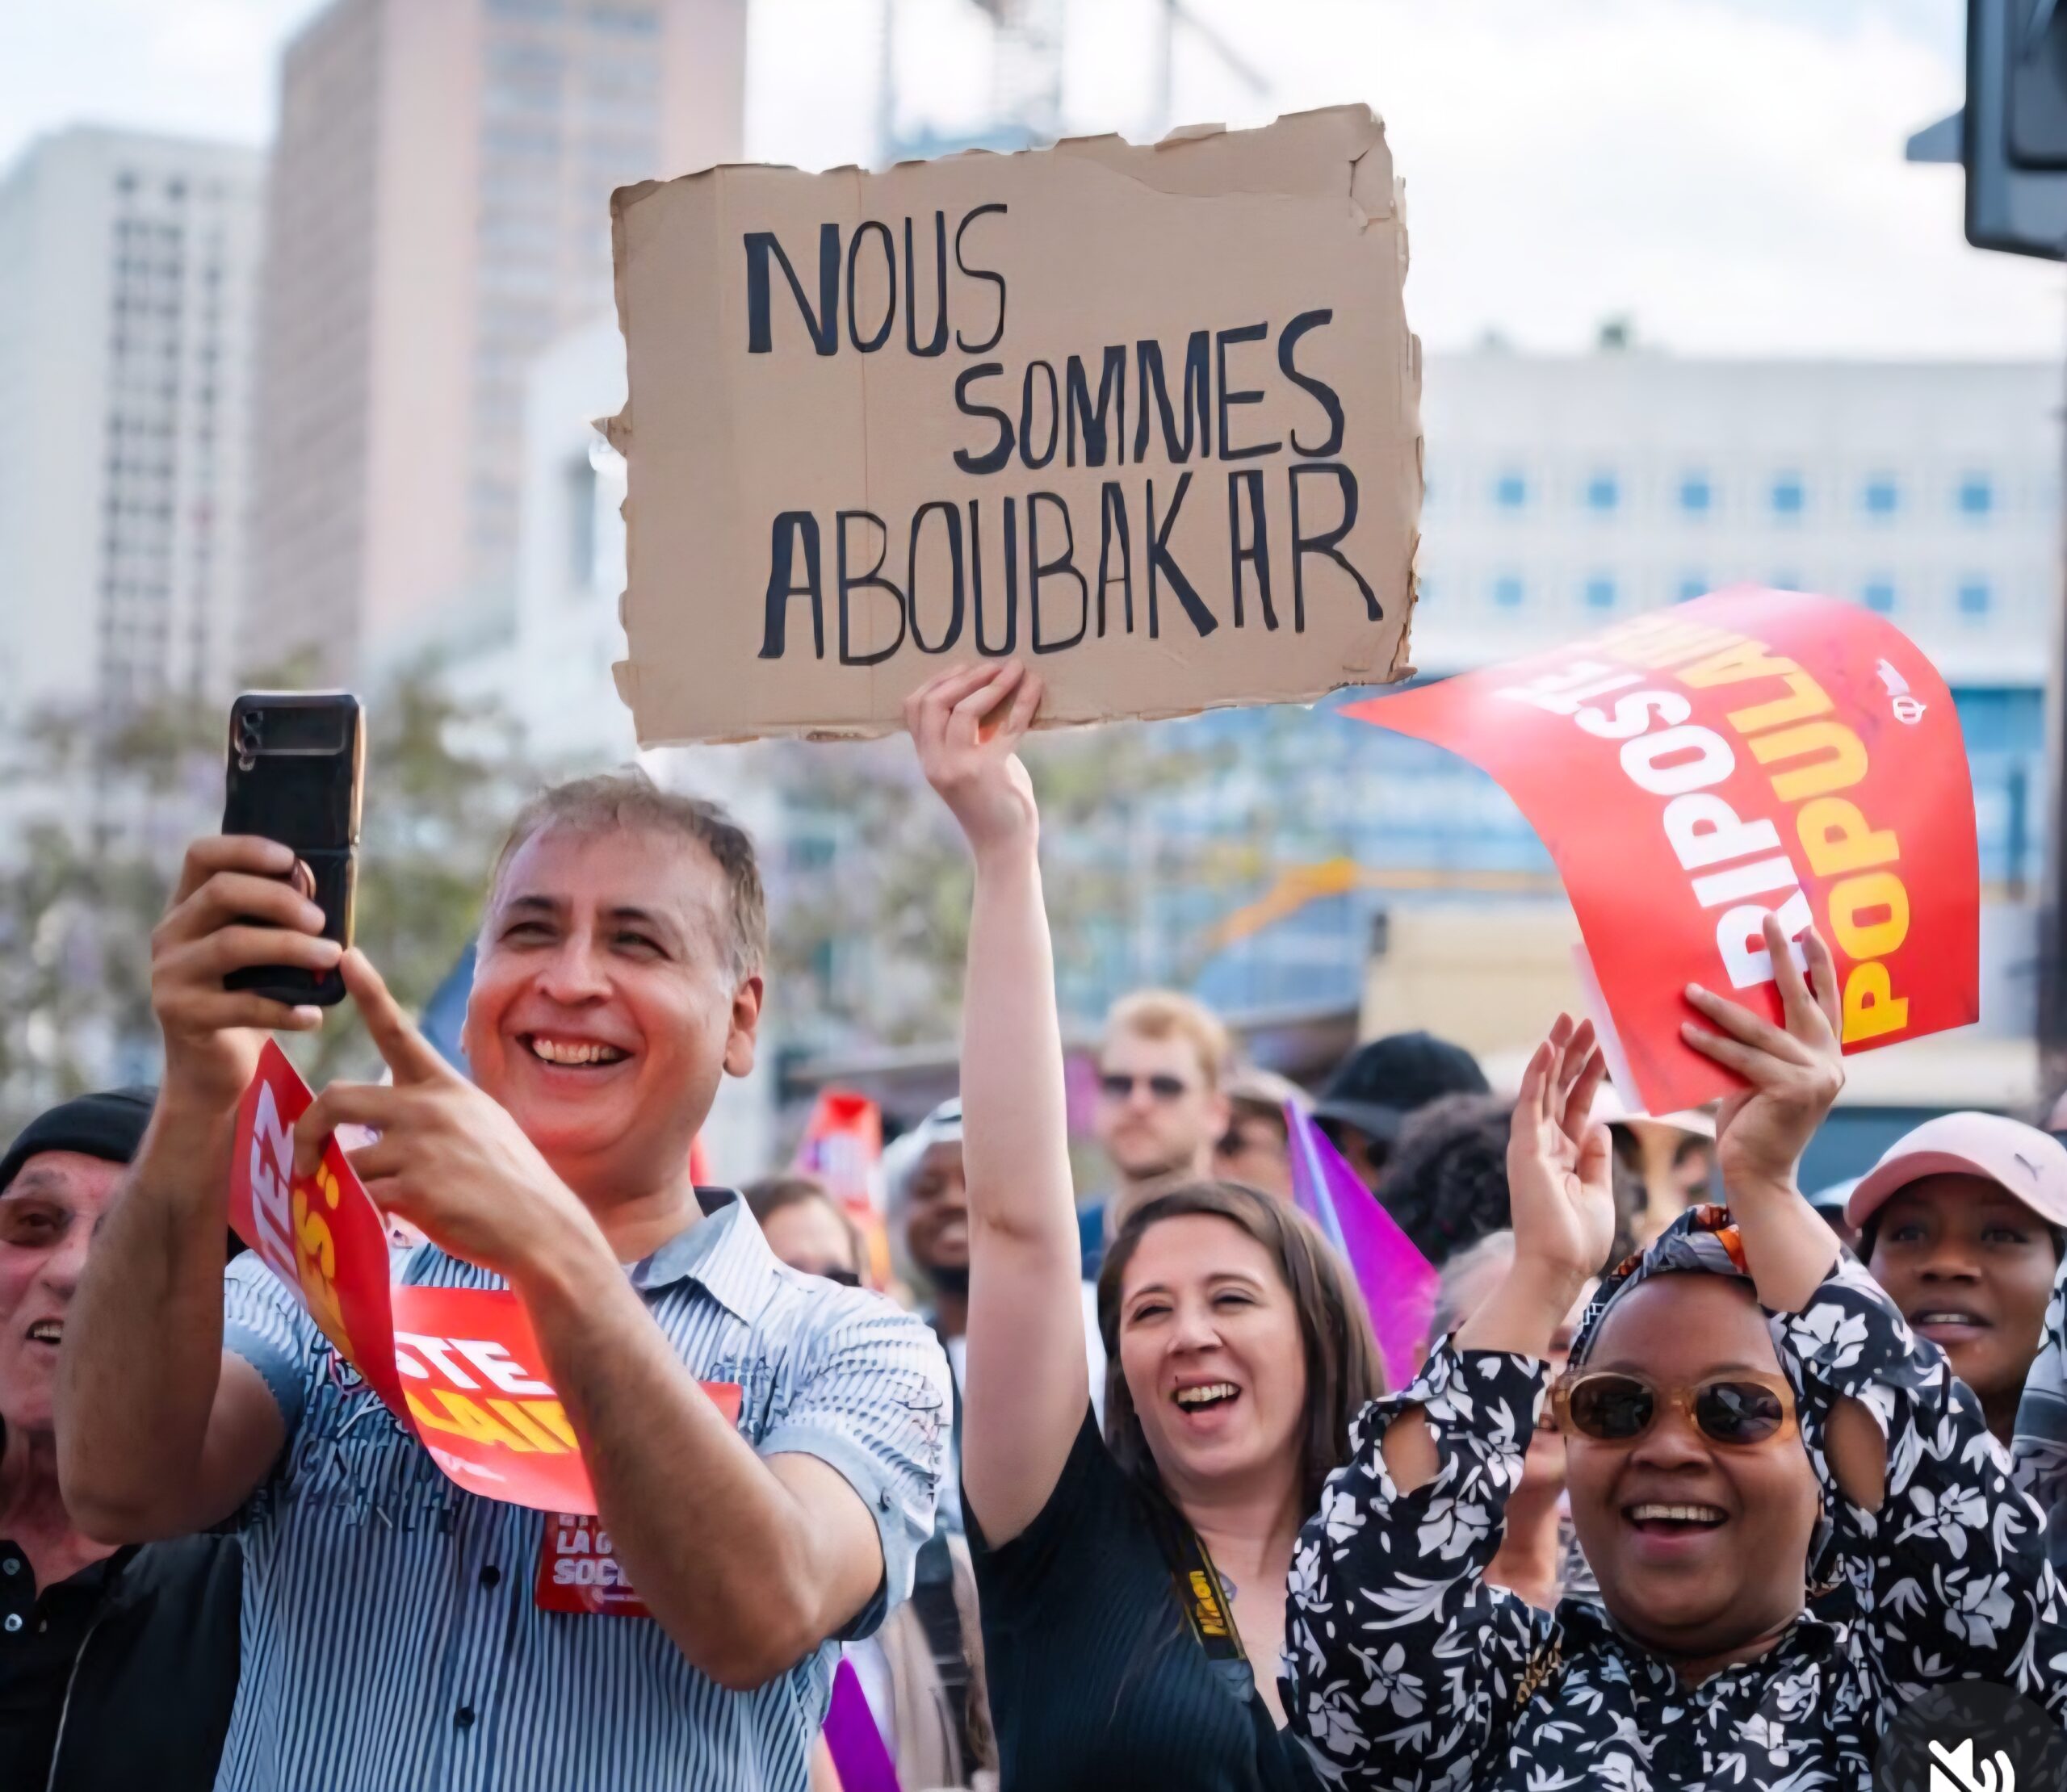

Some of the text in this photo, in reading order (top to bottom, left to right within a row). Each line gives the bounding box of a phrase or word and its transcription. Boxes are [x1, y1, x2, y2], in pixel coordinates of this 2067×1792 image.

[744, 203, 1008, 358] NOUS
[953, 308, 1345, 475] SOMMES
[757, 462, 1384, 666] ABOUBAKAR
